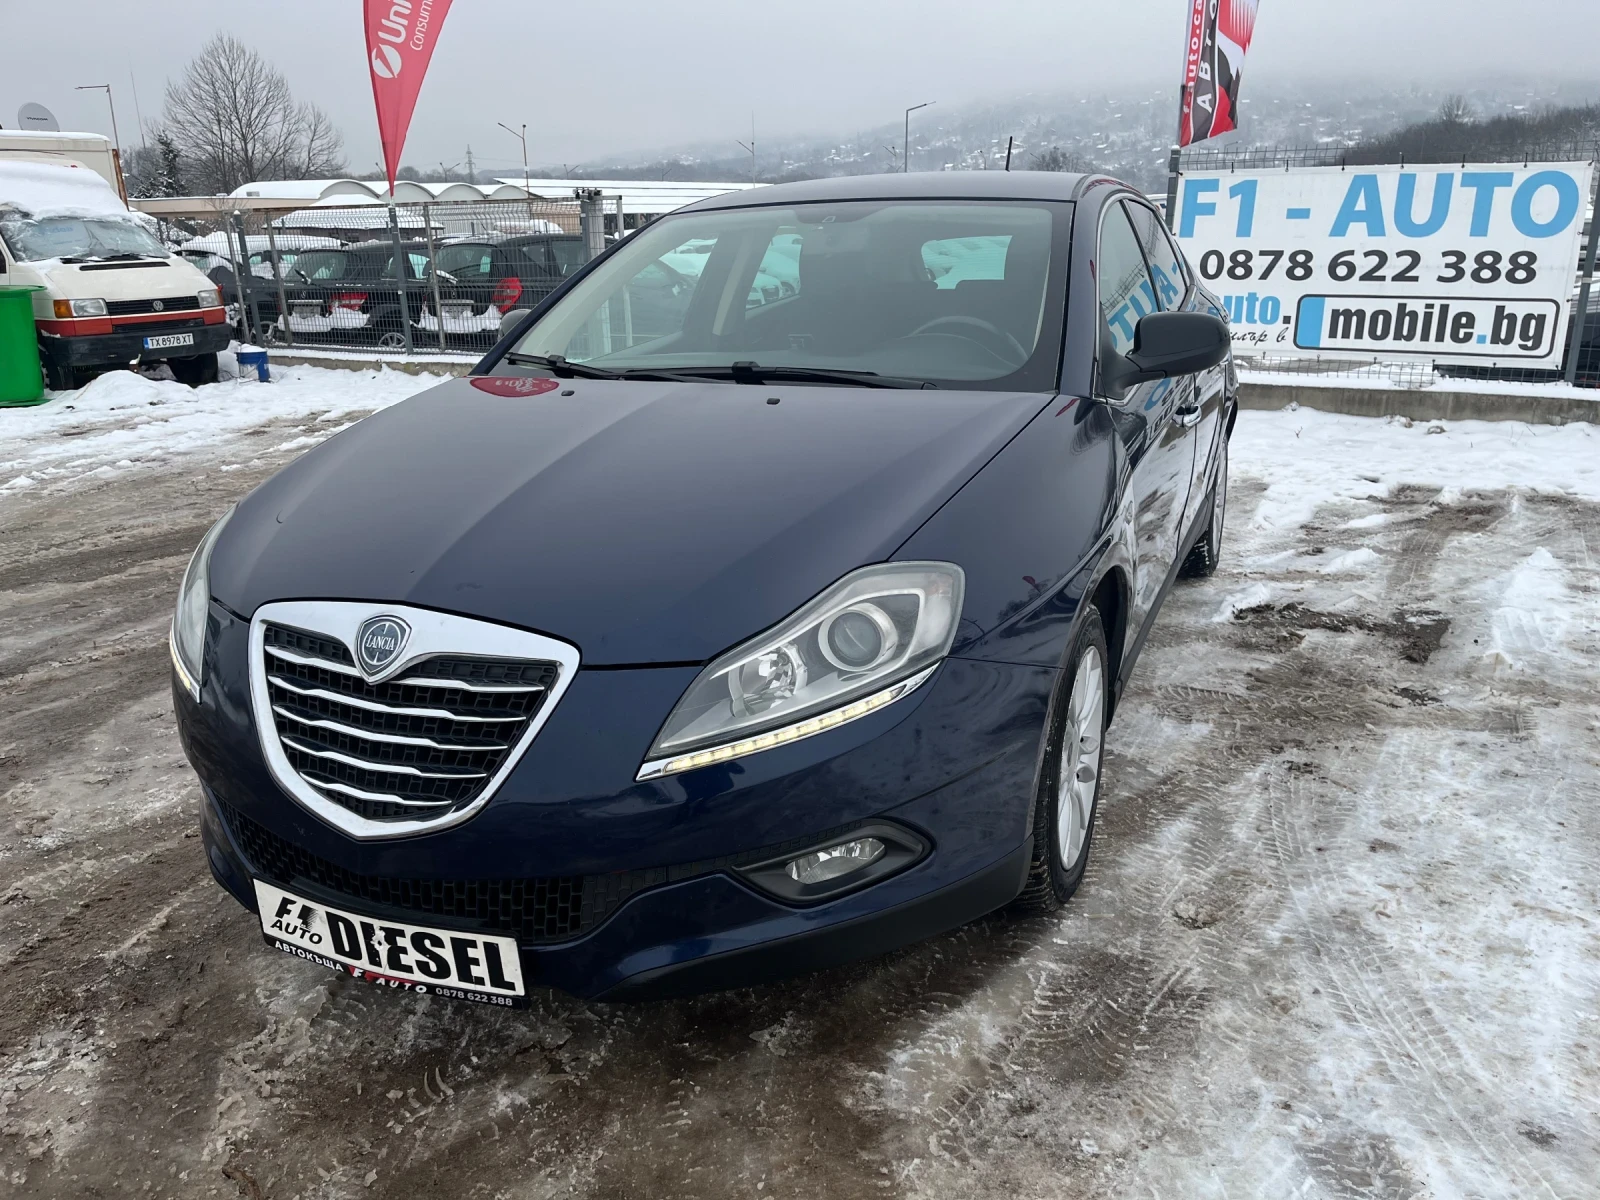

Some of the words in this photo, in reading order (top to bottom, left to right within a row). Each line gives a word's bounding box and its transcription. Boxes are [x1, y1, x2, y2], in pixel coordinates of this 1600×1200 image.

[410, 0, 434, 50] Consum
[1179, 179, 1258, 238] F1
[1328, 170, 1578, 238] AUTO
[1200, 249, 1313, 281] 0878
[1327, 250, 1421, 282] 622
[1436, 250, 1537, 284] 388
[1217, 292, 1291, 325] uto.
[1328, 303, 1547, 350] mobile.bg
[149, 338, 161, 347] TX
[162, 335, 181, 346] 8978
[182, 334, 192, 344] XT
[366, 634, 395, 650] LANCIA
[270, 919, 323, 945] AUTO
[325, 911, 517, 992] DIESEL
[275, 940, 344, 972] АВТОКЪЩА
[376, 977, 427, 994] AUTO
[435, 987, 465, 999] 0878
[467, 992, 489, 1003] 622
[490, 996, 513, 1007] 388
